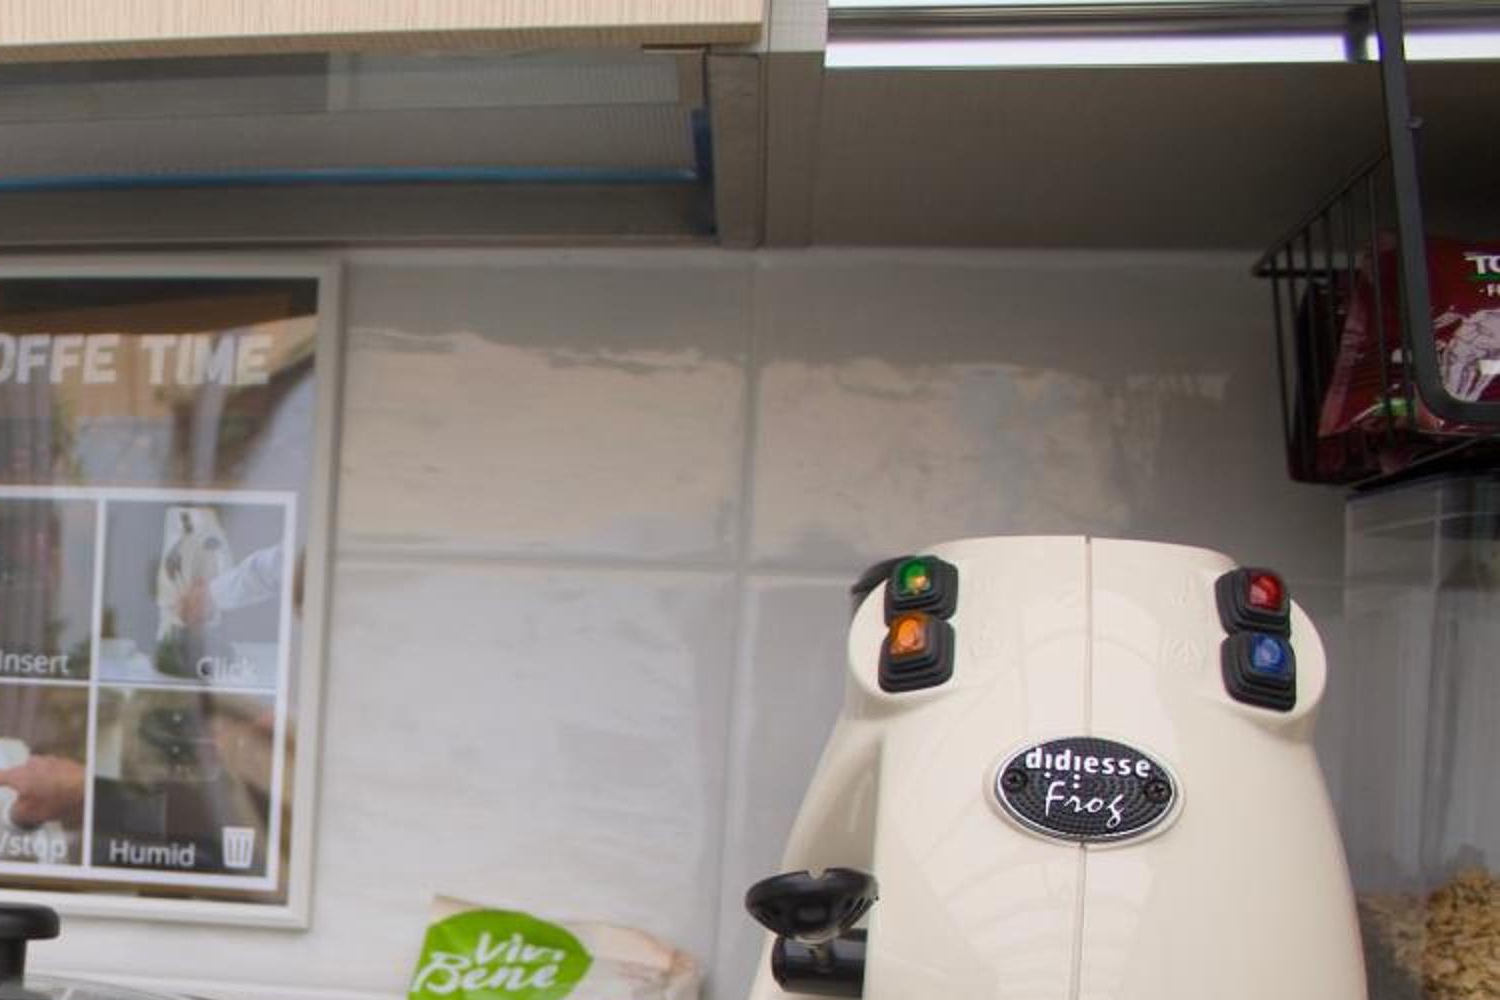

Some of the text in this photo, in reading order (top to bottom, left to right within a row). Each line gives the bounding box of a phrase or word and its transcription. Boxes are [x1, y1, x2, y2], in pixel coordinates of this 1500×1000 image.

[141, 333, 275, 386] TIME
[1025, 747, 1151, 780] didiesse
[109, 839, 196, 867] Humid
